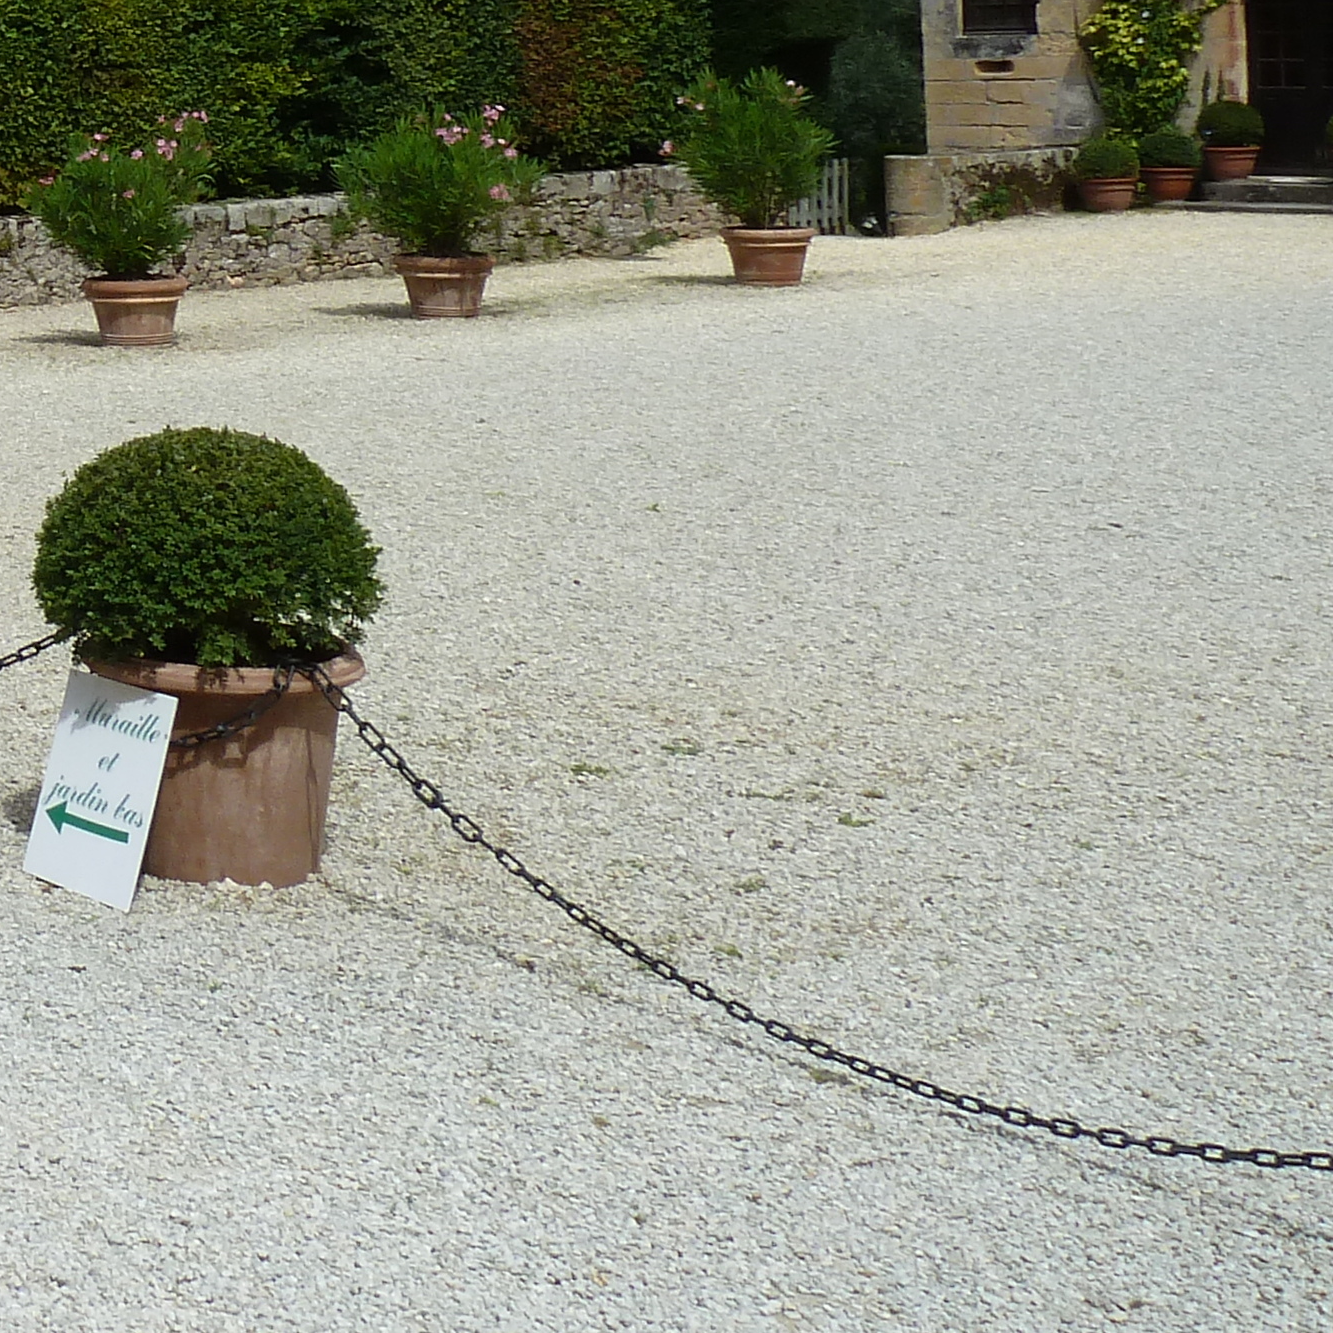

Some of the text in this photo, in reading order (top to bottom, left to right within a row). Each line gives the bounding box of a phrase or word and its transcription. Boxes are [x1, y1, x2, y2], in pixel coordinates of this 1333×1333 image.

[74, 697, 161, 743] Muraille
[98, 753, 120, 772] et
[44, 775, 143, 828] jardin bas
